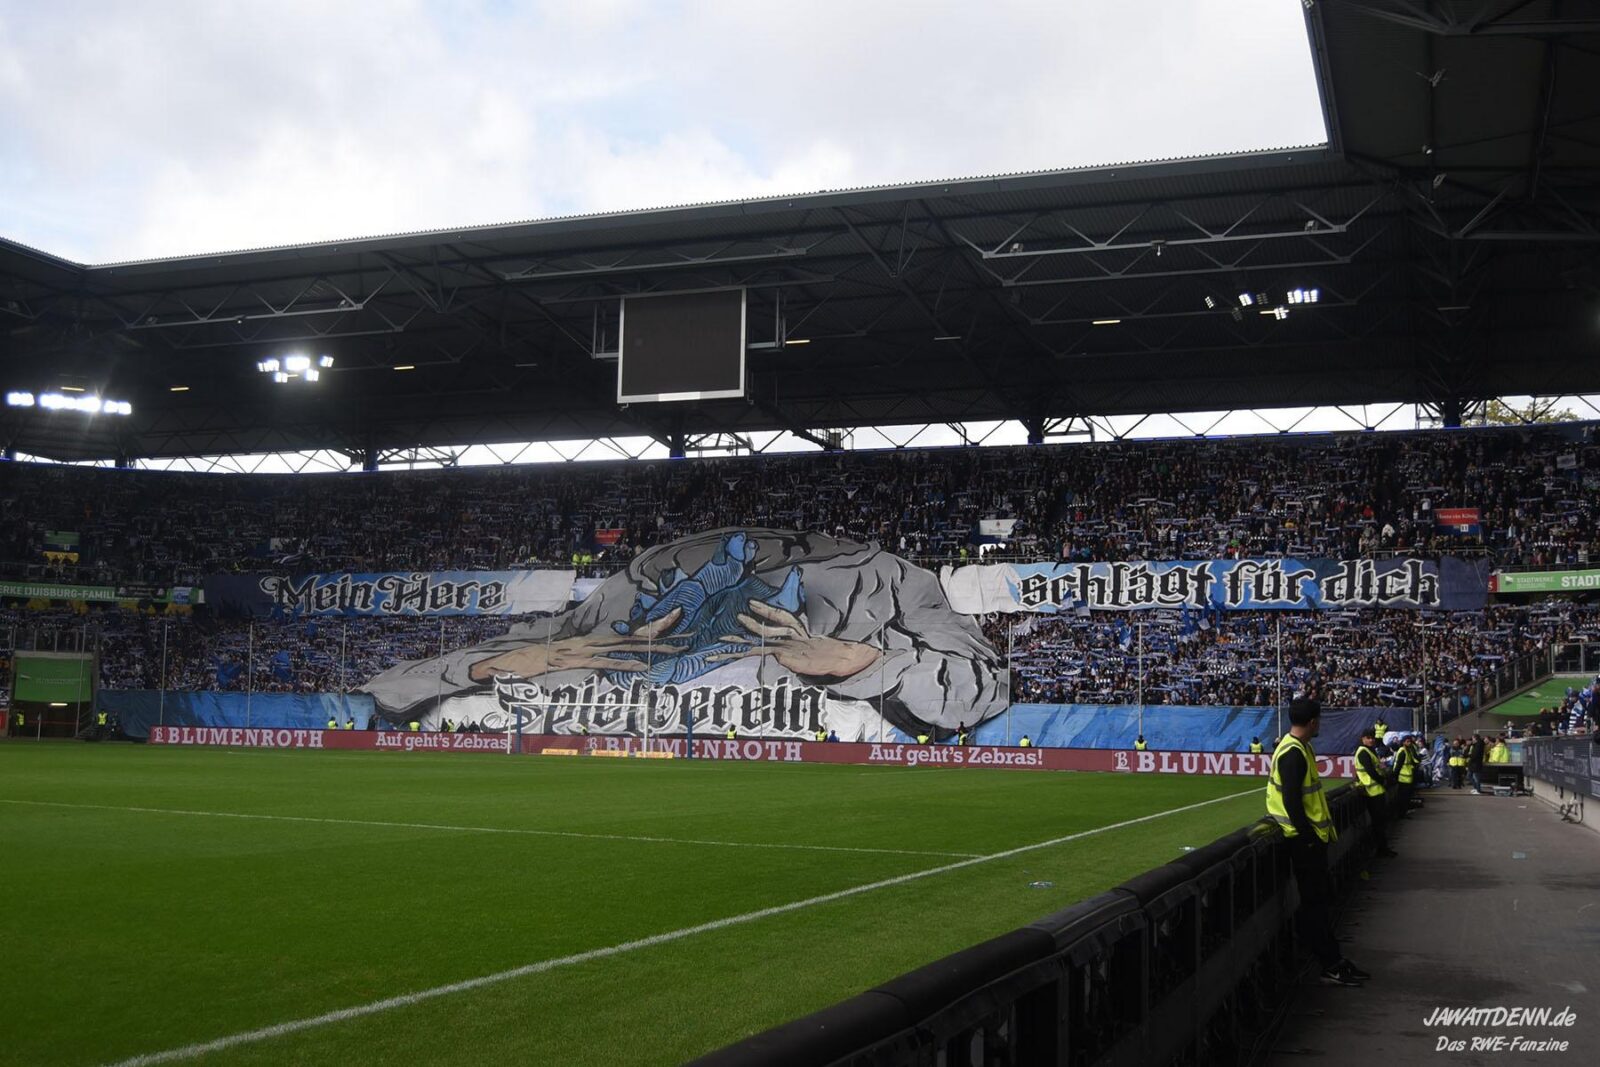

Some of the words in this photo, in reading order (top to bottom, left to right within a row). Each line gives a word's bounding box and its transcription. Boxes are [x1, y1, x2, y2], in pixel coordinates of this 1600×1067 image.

[24, 586, 115, 599] DUISBURG-FAMILI
[259, 574, 375, 614] Mein
[1018, 560, 1217, 609] schlägt
[1223, 559, 1316, 607] für
[1321, 558, 1441, 607] dich
[480, 673, 828, 738] Spielverein
[168, 727, 324, 747] BLUMENROTH
[376, 732, 404, 746] Auf
[405, 733, 450, 750] geht's
[605, 737, 802, 761] BLUMENROTH
[868, 744, 903, 761] Auf
[907, 746, 963, 766] geht's
[968, 747, 1043, 766] Zebras!
[1137, 751, 1355, 778] BLUMENOT
